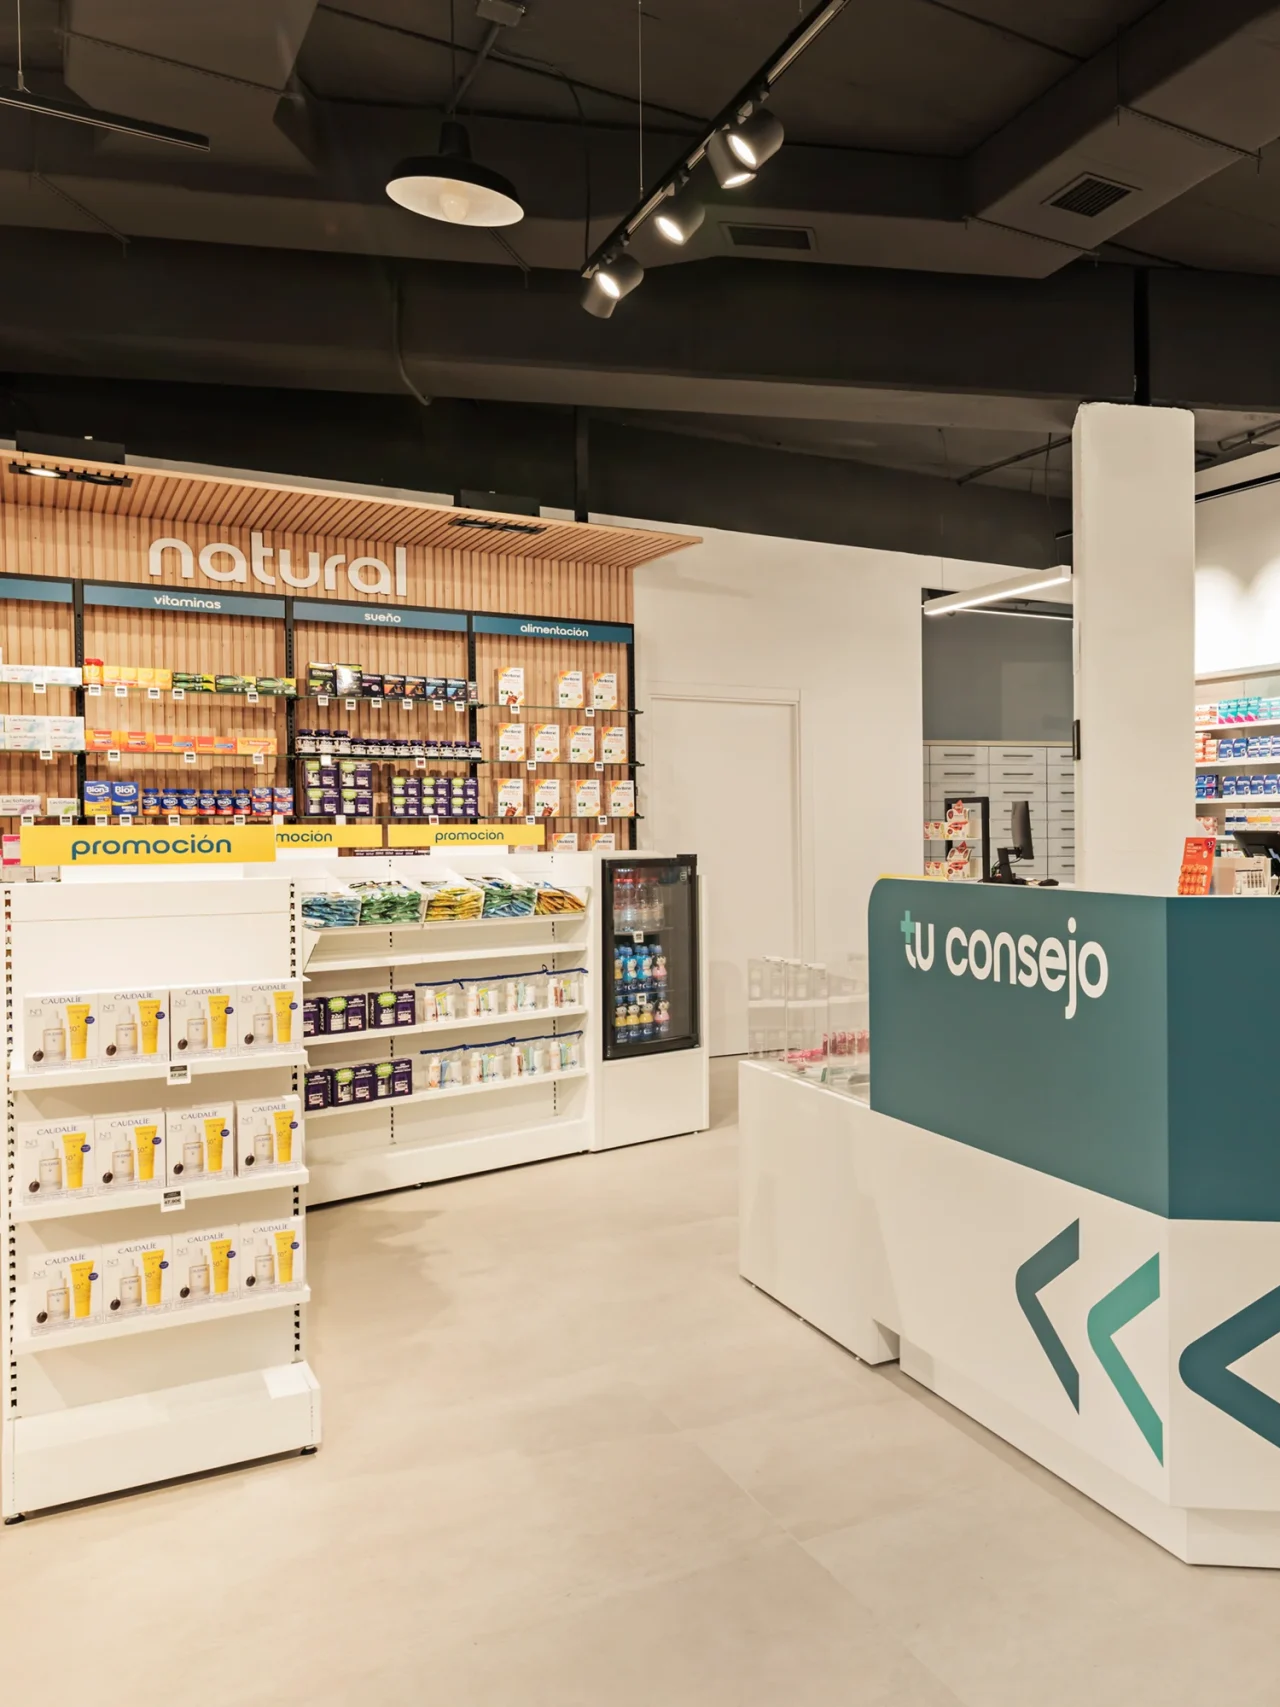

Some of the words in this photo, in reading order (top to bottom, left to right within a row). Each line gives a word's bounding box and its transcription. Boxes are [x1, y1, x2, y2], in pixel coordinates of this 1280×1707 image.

[149, 532, 407, 597] natural
[154, 595, 221, 609] vitaminas
[364, 612, 401, 623] sueño
[520, 623, 588, 637] alimentación
[276, 830, 332, 843] moción
[435, 830, 504, 843] promoción
[71, 834, 231, 860] promoción
[900, 910, 934, 971] tu
[945, 917, 1108, 1019] consejo
